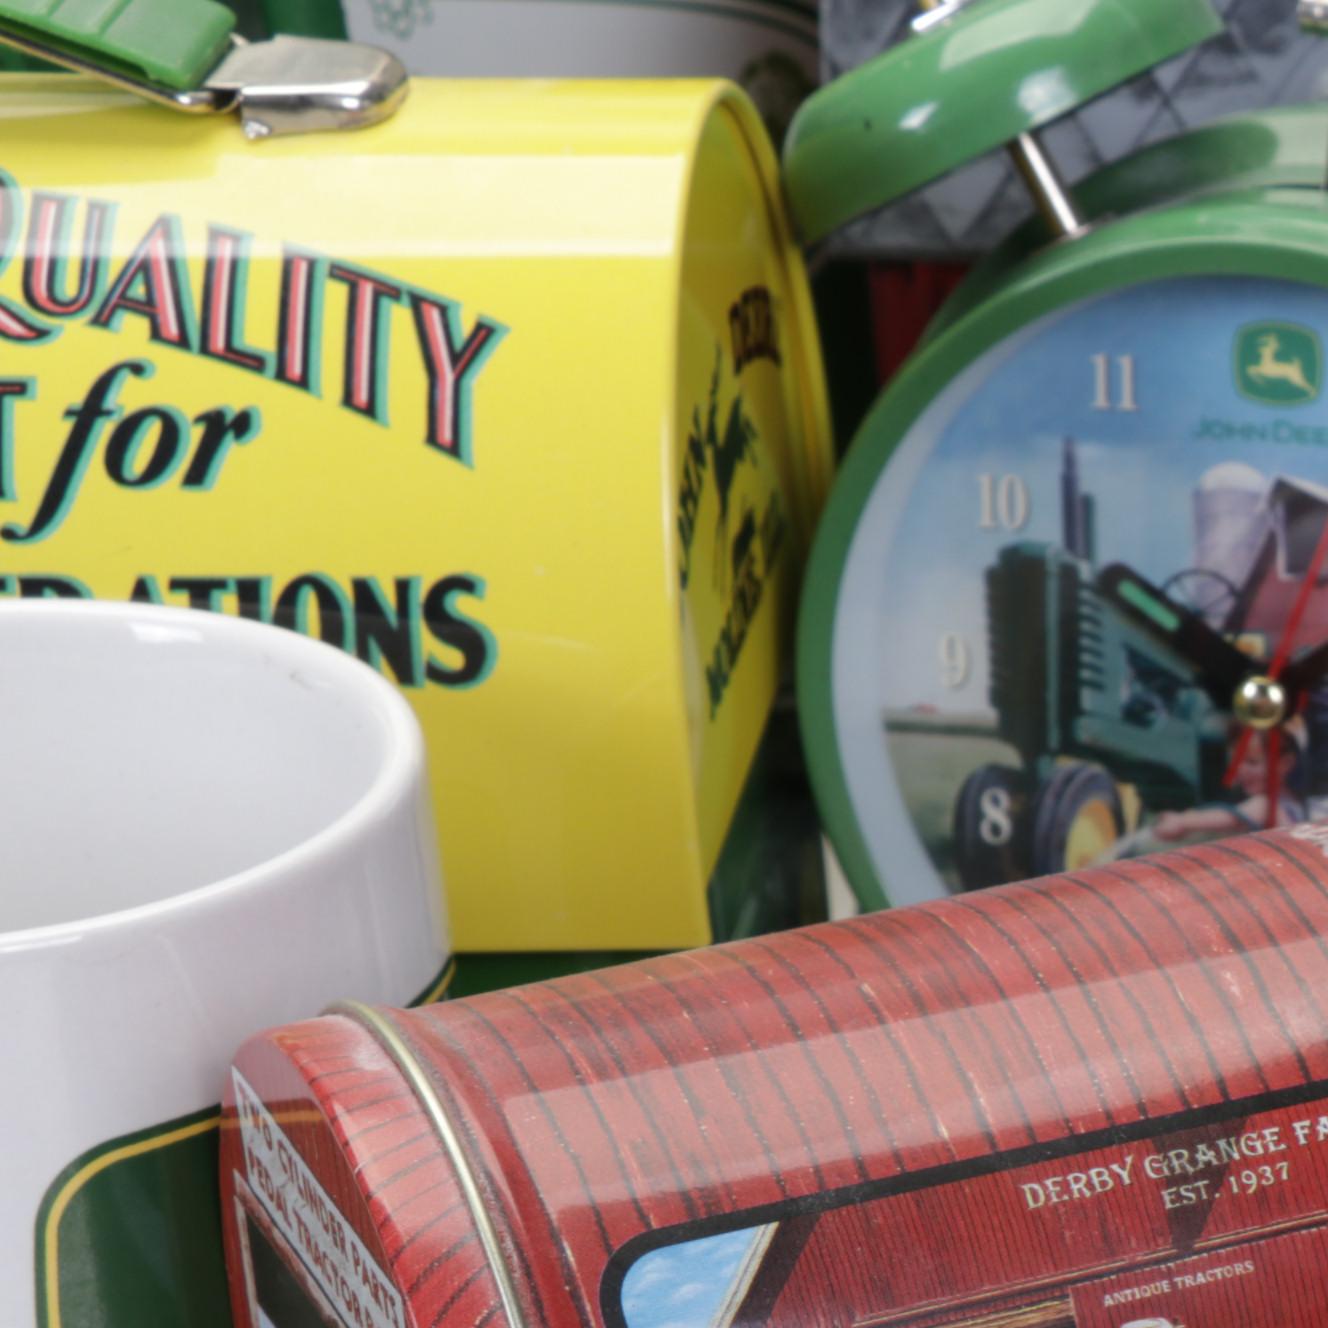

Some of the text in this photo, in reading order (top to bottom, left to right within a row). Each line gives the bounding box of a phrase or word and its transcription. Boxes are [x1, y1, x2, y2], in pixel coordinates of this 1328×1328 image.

[1089, 352, 1139, 412] 11
[0, 359, 261, 545] for
[976, 471, 1030, 530] 10
[939, 633, 969, 690] 9
[979, 786, 1014, 846] 8
[276, 1140, 350, 1256] CYLINDER
[1021, 1155, 1134, 1211] DERBY
[1143, 1126, 1288, 1181] GRANGE
[1161, 1161, 1291, 1211] EST. 1937
[1102, 1259, 1255, 1308] ANTIQUE TRACTORS
